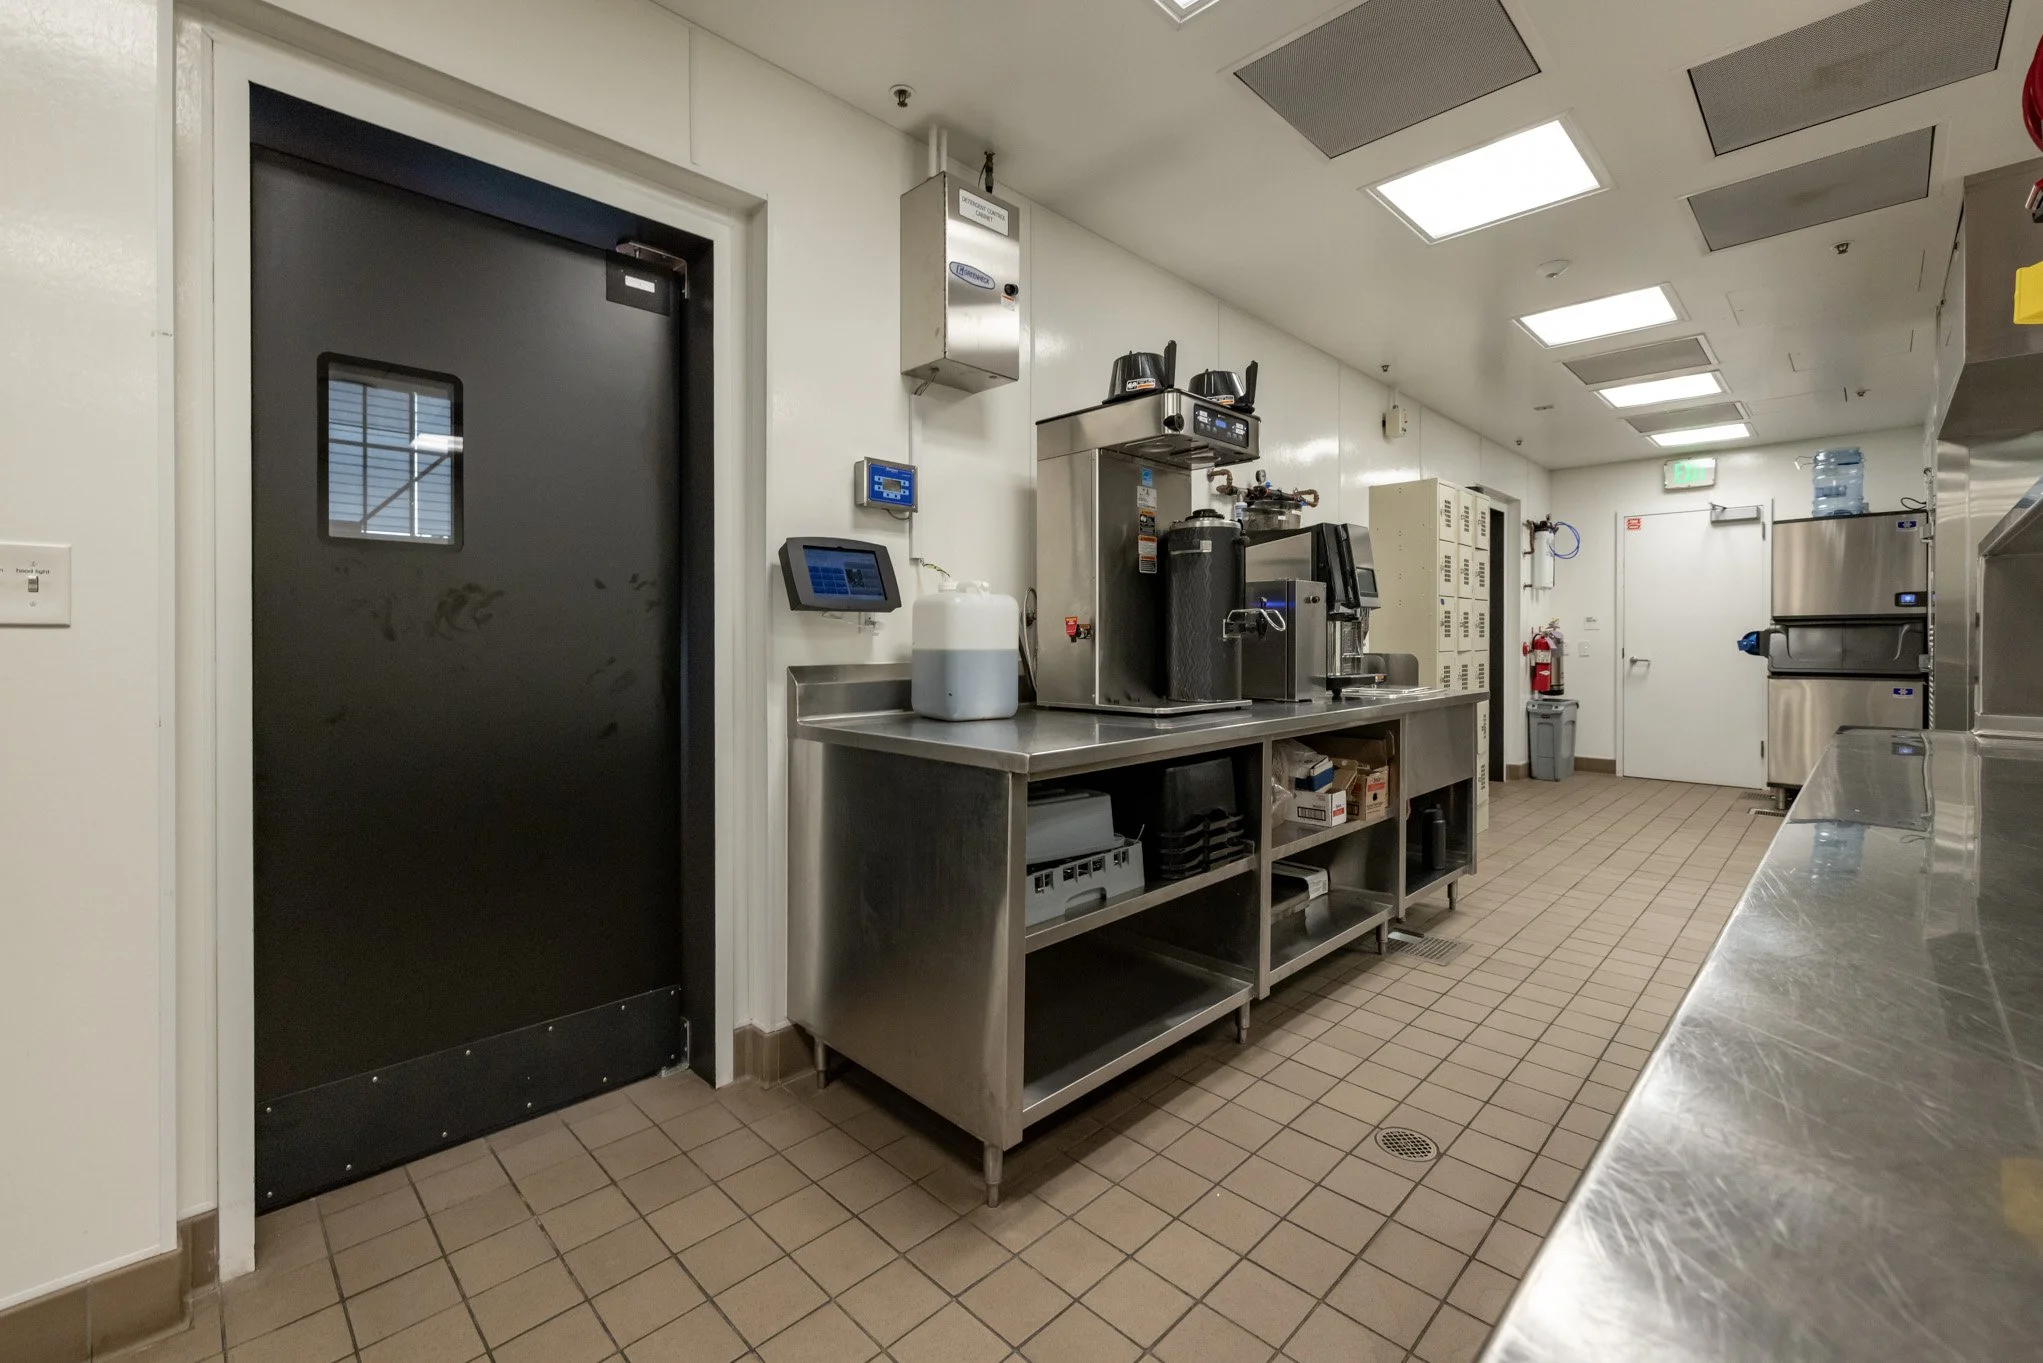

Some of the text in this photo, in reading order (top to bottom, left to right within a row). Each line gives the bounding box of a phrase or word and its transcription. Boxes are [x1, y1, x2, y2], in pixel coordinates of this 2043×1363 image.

[961, 196, 1006, 221] DETERGENT CONTROL
[975, 210, 993, 222] CABINET
[963, 268, 990, 285] GREENHECK
[1674, 463, 1707, 484] EXIT
